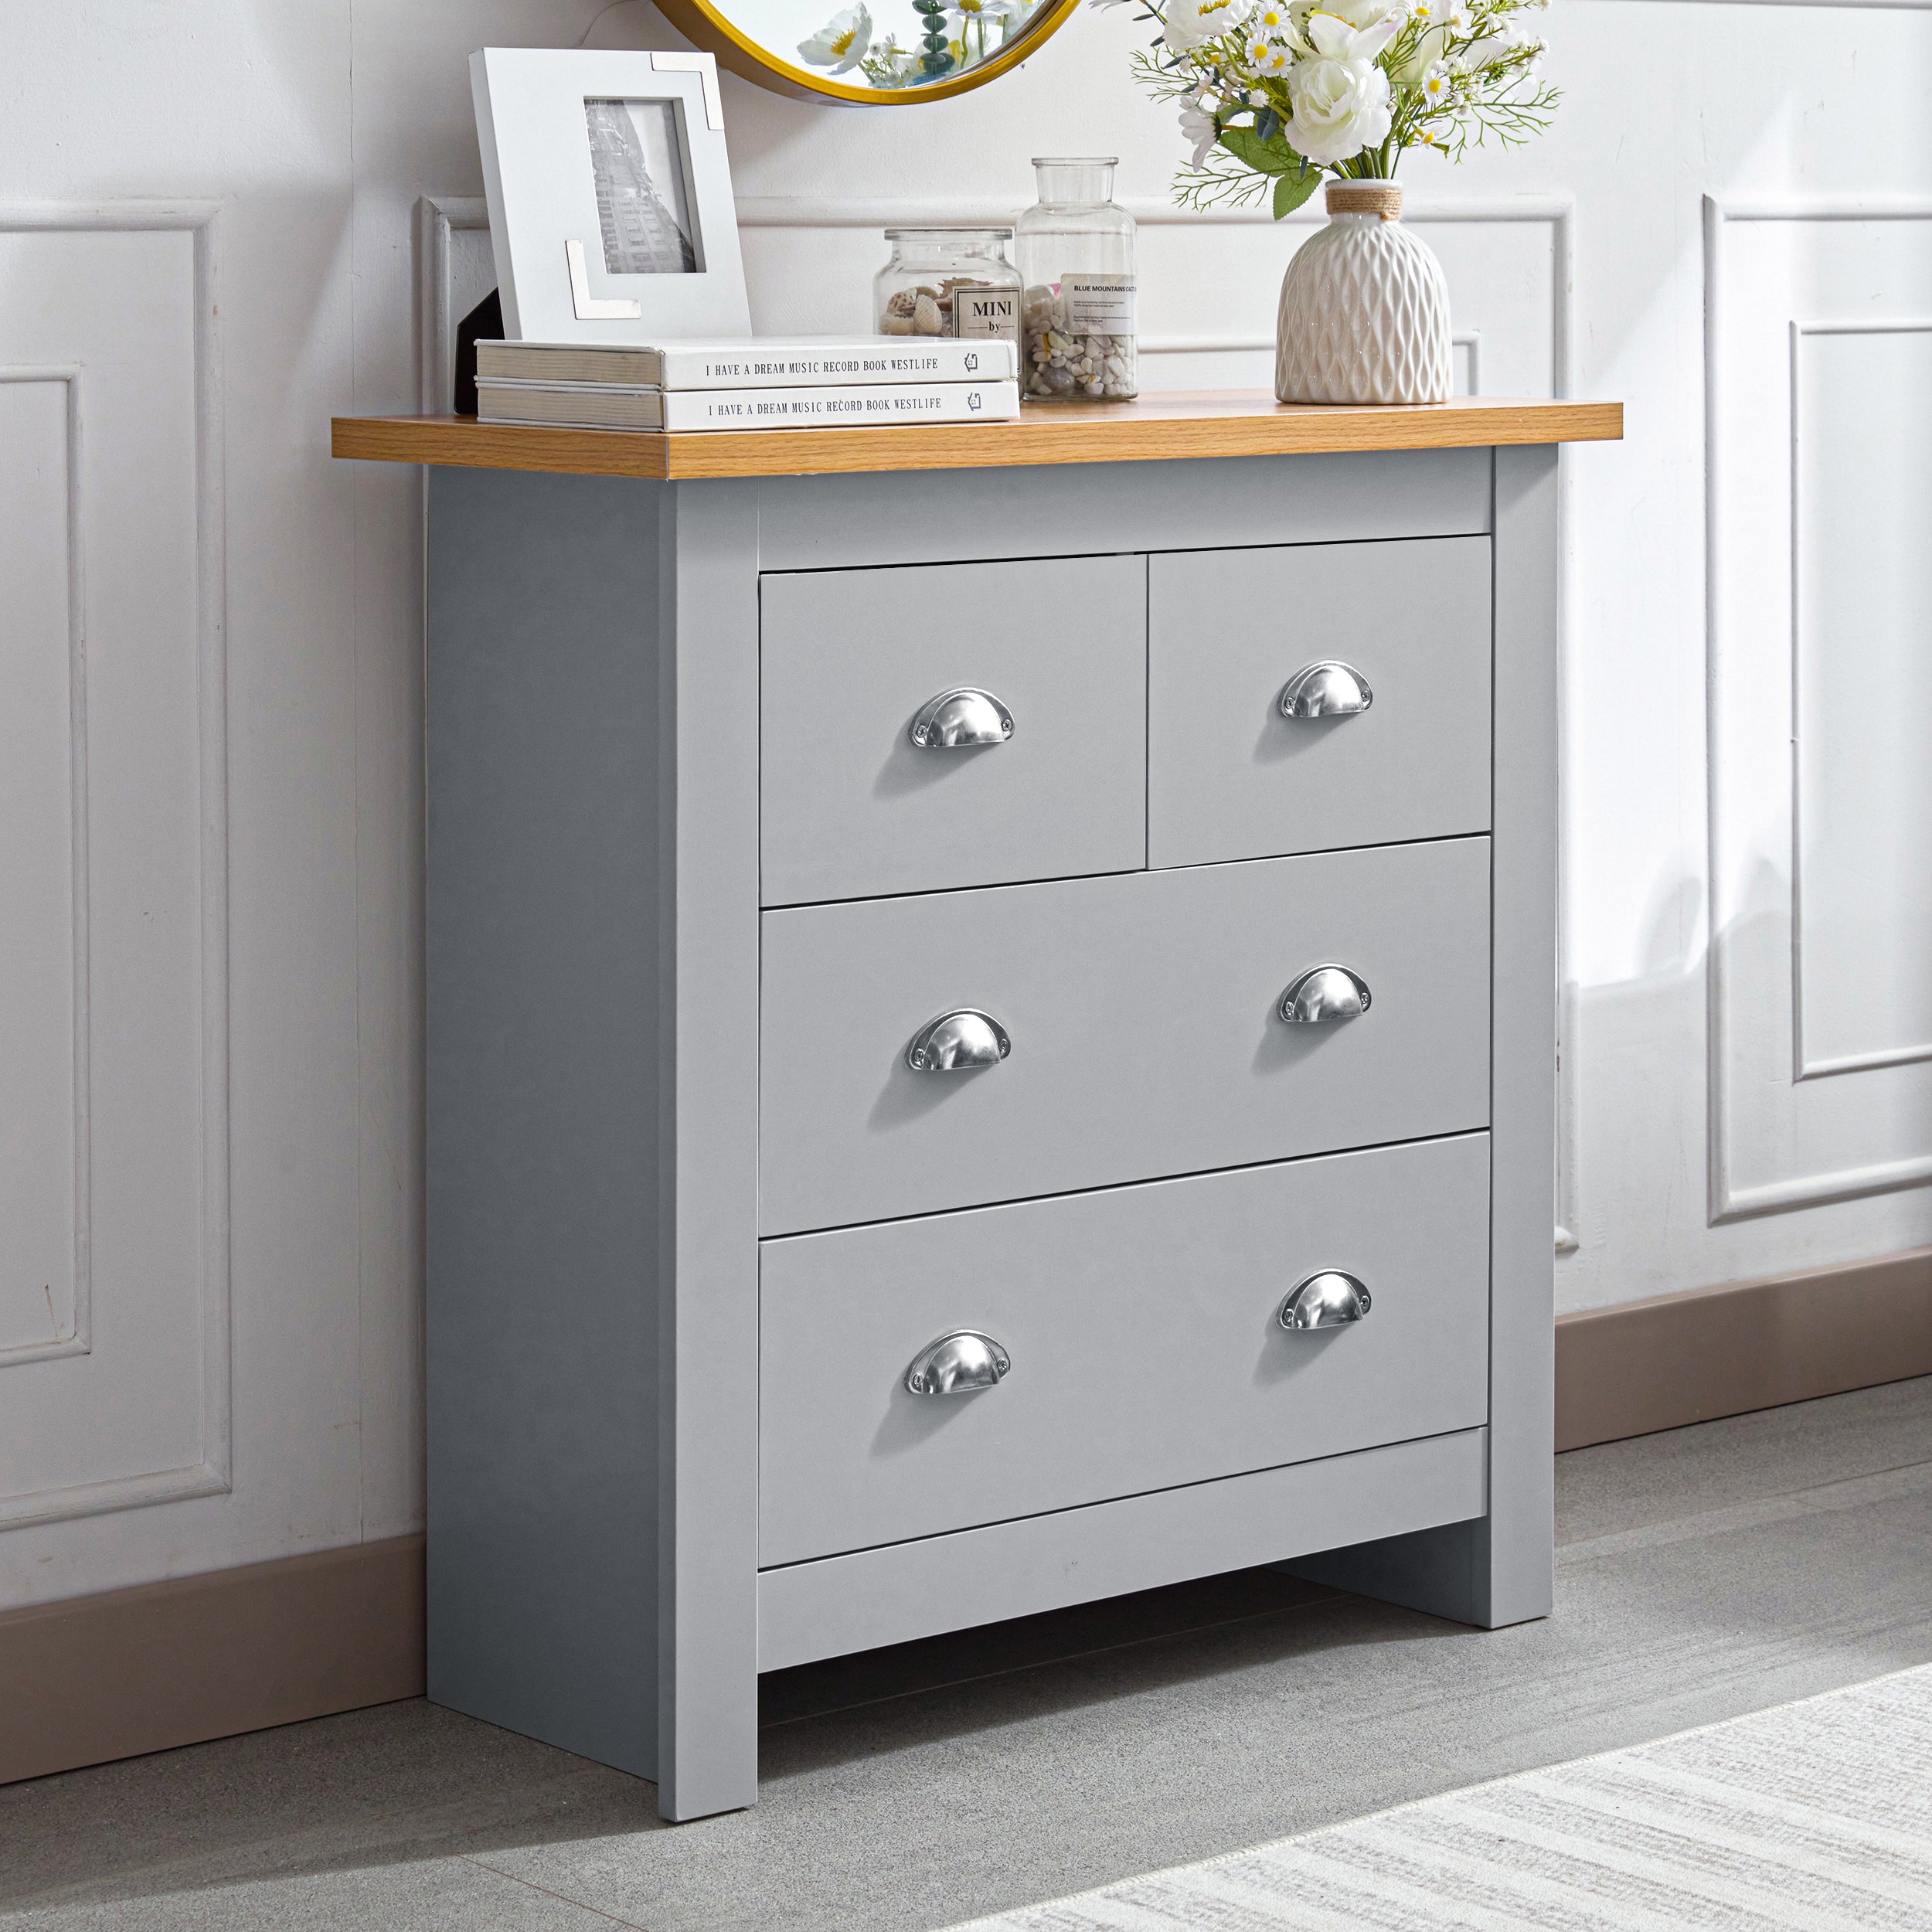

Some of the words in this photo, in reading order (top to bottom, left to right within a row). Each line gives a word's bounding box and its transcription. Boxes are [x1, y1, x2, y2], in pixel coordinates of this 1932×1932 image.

[972, 301, 1012, 316] MINI
[988, 321, 1000, 333] by
[706, 365, 709, 376] I
[715, 364, 740, 376] HAVE
[743, 364, 750, 375] A
[754, 362, 784, 375] DREAM
[789, 362, 819, 373] MUSIC
[823, 361, 859, 372] RECORD
[863, 359, 887, 371] BOOK
[890, 358, 938, 370] WESTLIFE
[709, 405, 713, 416] I
[718, 404, 743, 416] HAVE
[747, 403, 753, 415] A
[757, 403, 787, 414] DREAM
[791, 401, 822, 413] MUSIC
[826, 400, 862, 412] RECORD
[866, 399, 890, 411] BOOK
[893, 397, 941, 410] WESTLIFE
